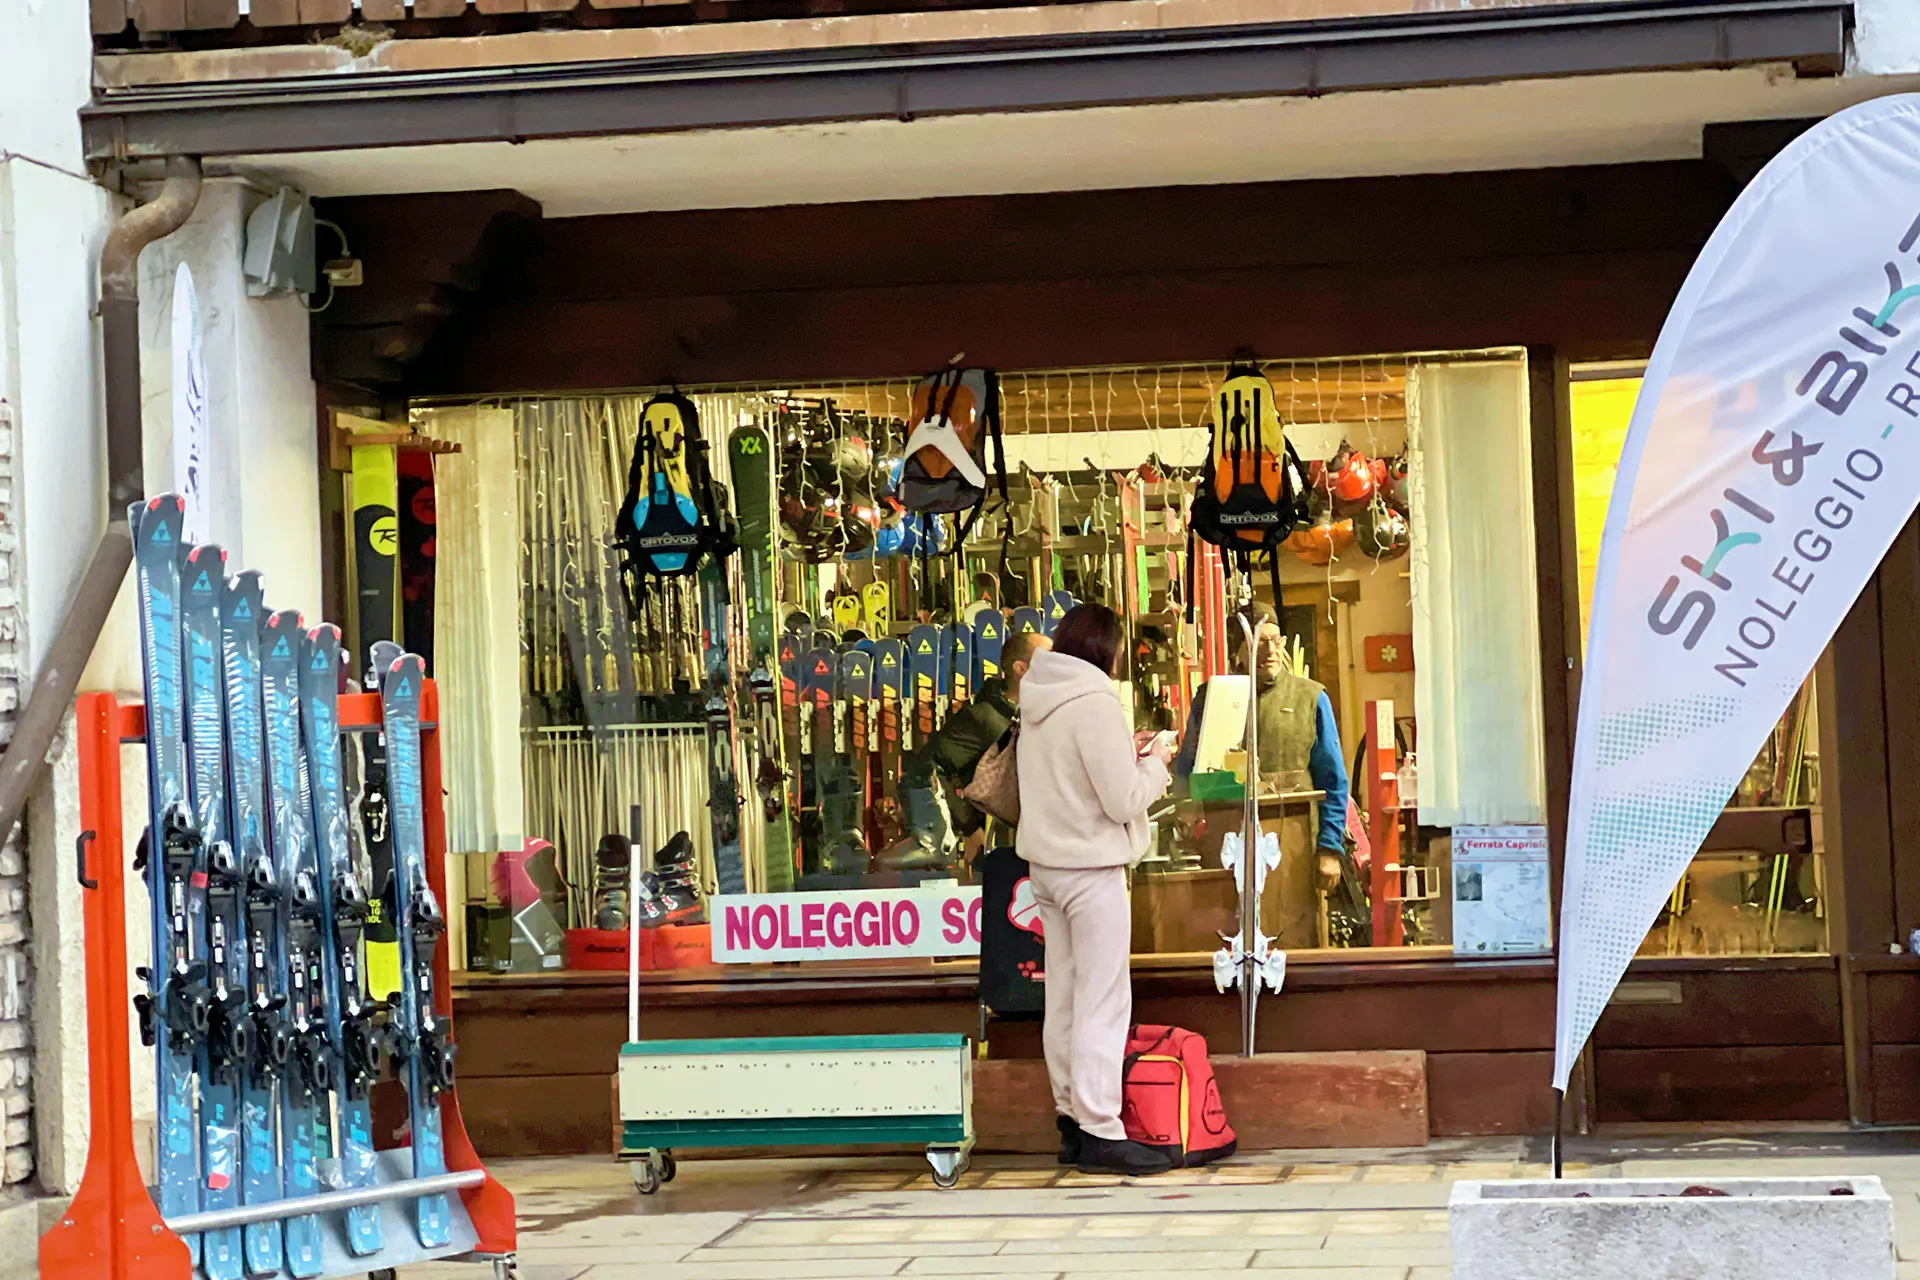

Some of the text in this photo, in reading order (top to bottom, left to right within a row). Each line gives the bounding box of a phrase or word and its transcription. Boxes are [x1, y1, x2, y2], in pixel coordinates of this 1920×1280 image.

[1647, 488, 1775, 650] SKI
[1753, 430, 1824, 487] &
[1714, 448, 1883, 687] NOLEGGIO
[1467, 840, 1503, 849] Ferrata
[725, 899, 920, 950] NOLEGGIO
